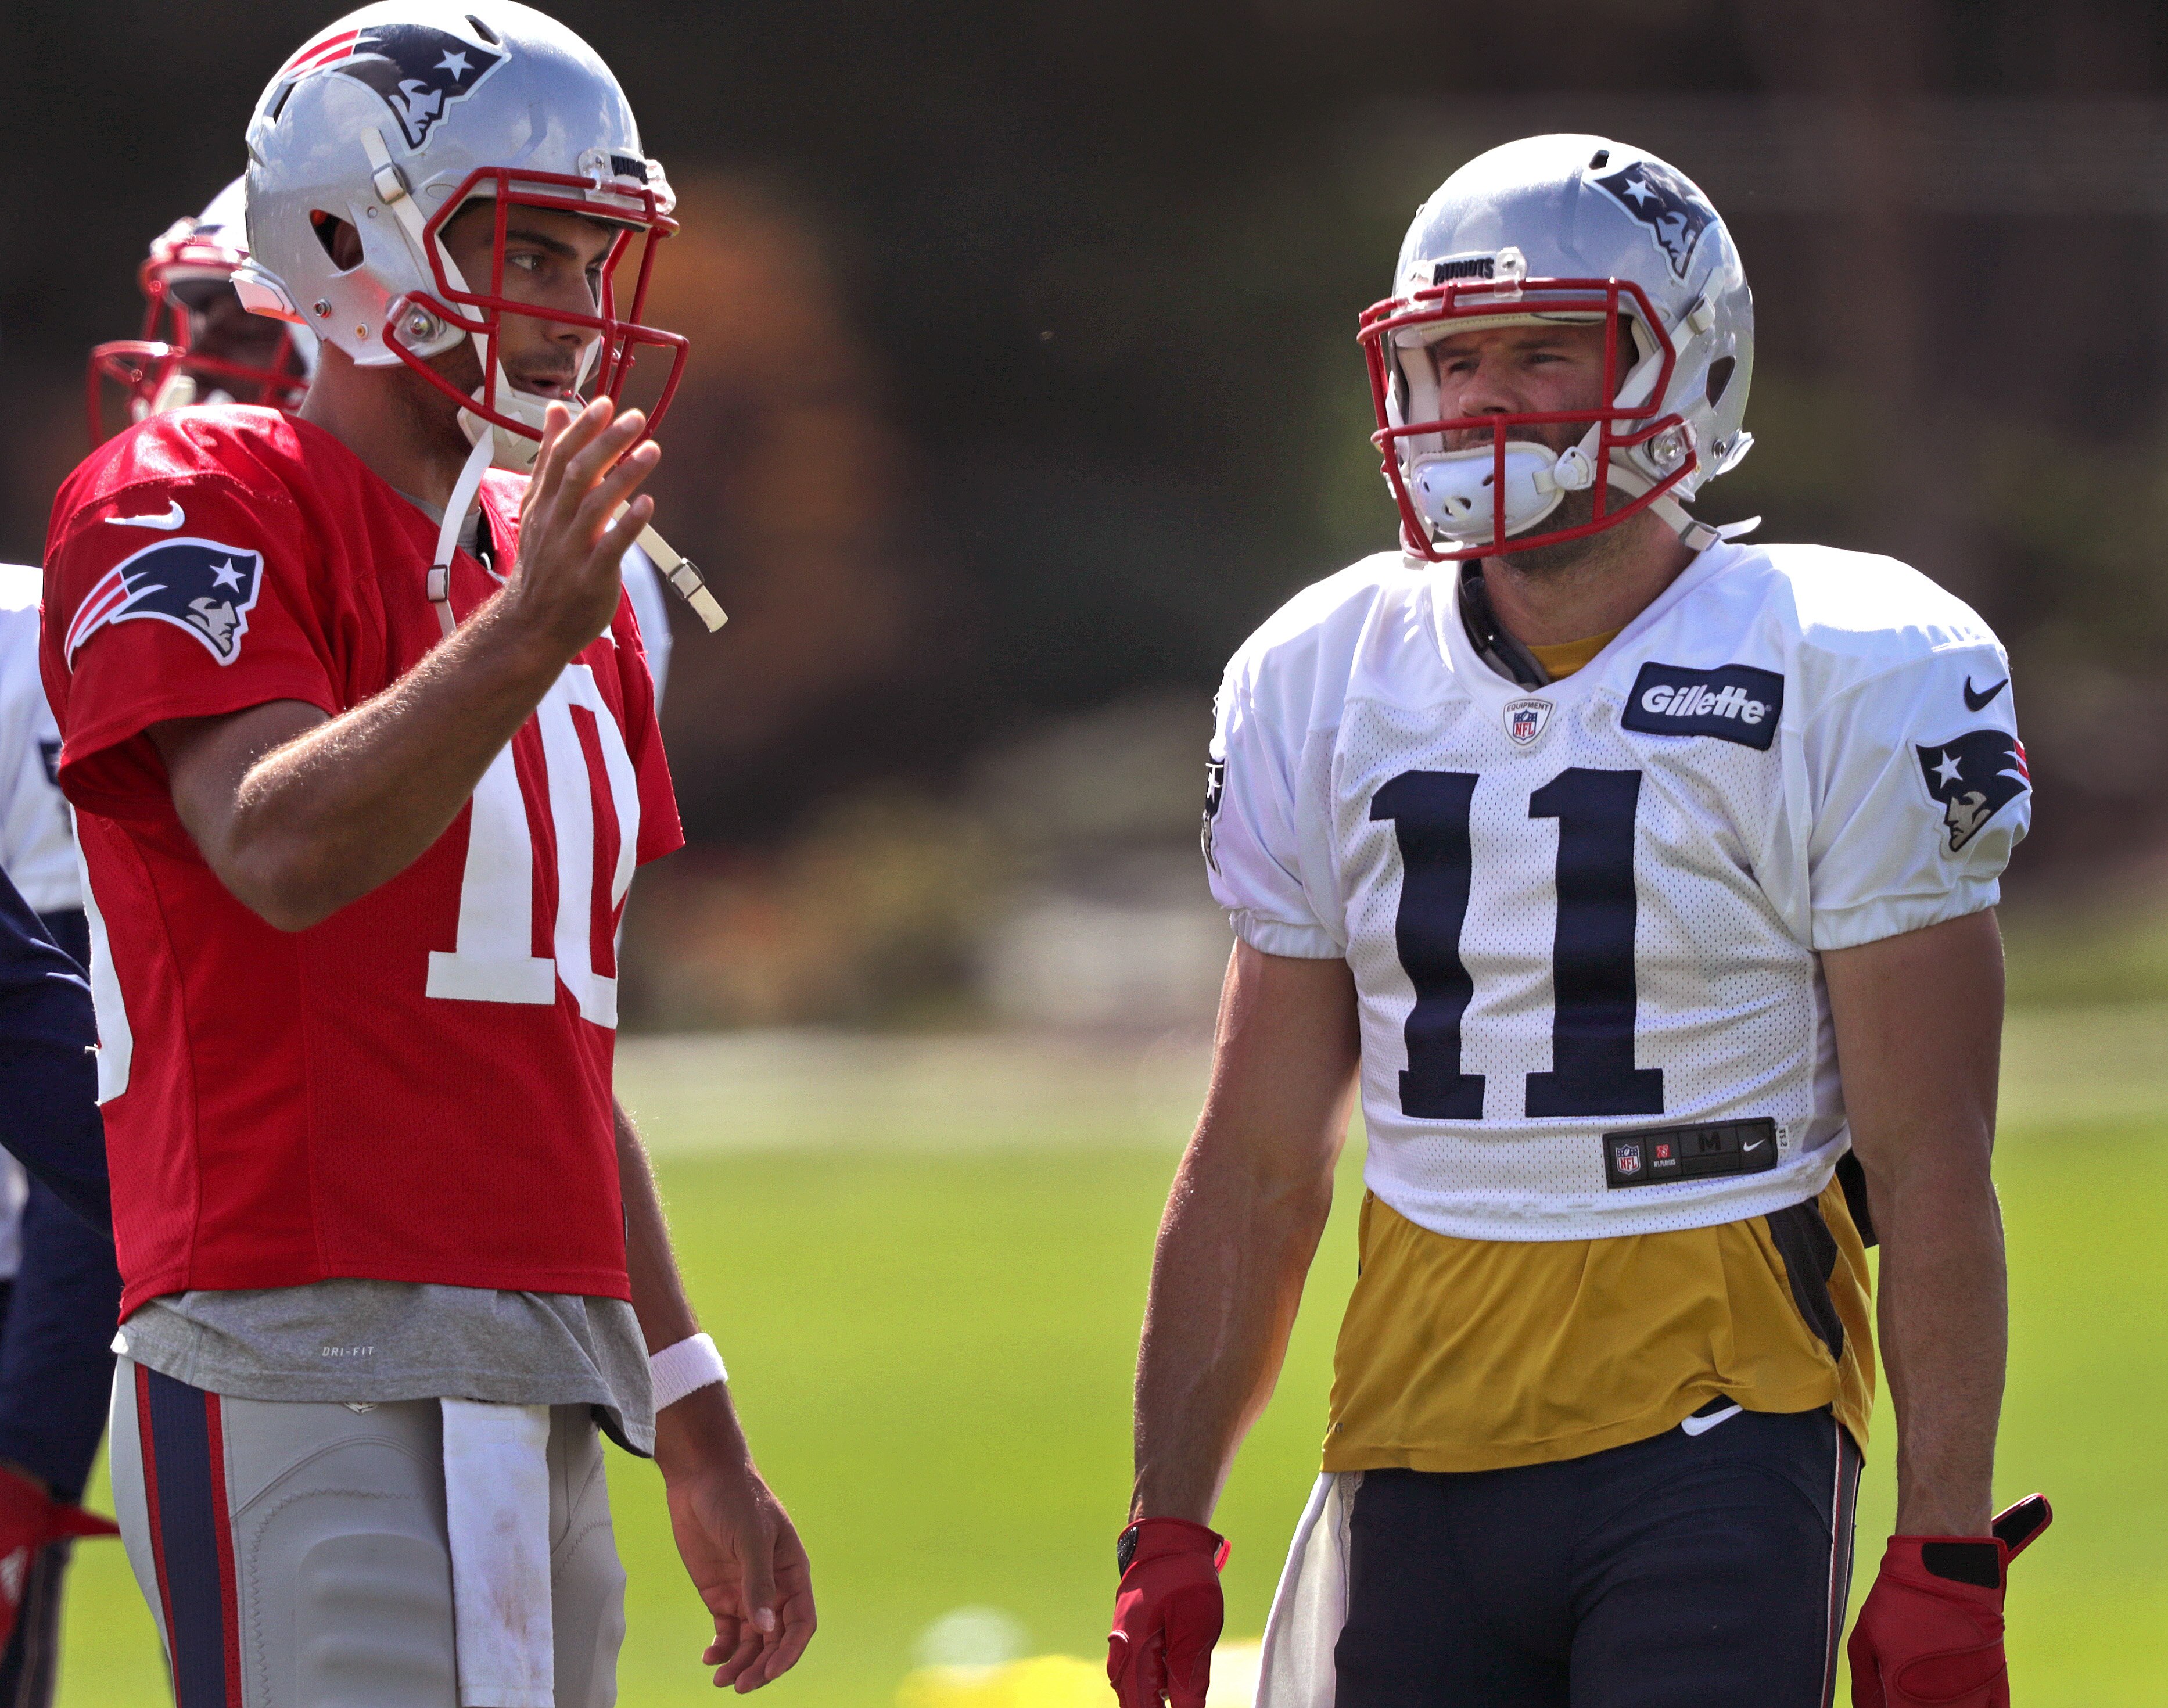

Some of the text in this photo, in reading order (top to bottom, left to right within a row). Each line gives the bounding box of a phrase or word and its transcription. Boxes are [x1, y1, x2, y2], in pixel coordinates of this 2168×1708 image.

[1433, 257, 1494, 286] PATRIOTS
[1506, 702, 1549, 712] EQUIPMENT
[1641, 684, 1765, 724] Gillette
[1515, 721, 1534, 737] NFL
[426, 663, 641, 1029] 10
[1369, 767, 1664, 1120] 11
[1697, 1131, 1722, 1153] M
[1620, 1157, 1637, 1170] NFL
[322, 1346, 375, 1357] DRI-FIT
